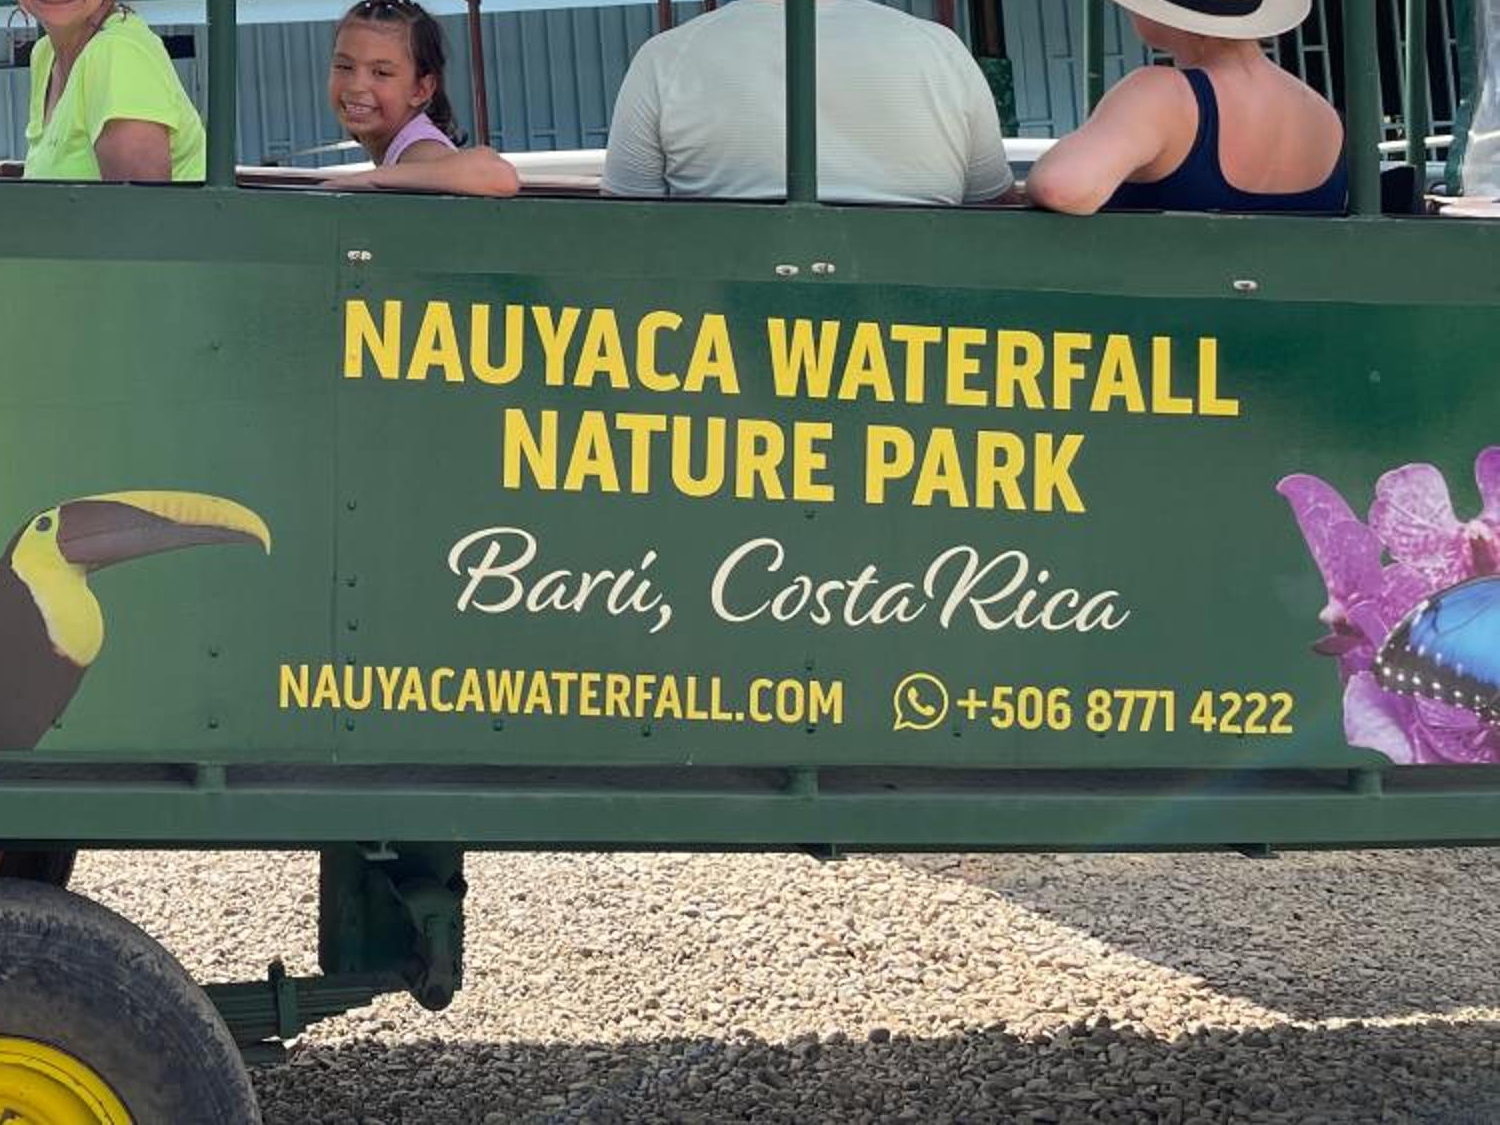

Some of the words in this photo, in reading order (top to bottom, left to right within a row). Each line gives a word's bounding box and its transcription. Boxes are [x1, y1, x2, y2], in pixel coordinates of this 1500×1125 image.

[344, 299, 739, 394] NAUYACA
[768, 318, 1239, 416] WATERFALL
[504, 408, 835, 502] NATURE
[866, 425, 1085, 513] PARK
[447, 527, 672, 634] Barú,
[711, 537, 926, 627] Costa
[924, 545, 1131, 632] Rica
[279, 664, 843, 724] NAUYACAWATERFALL.COM
[957, 686, 1072, 730] +506
[1086, 689, 1176, 732] 8771
[1190, 691, 1294, 733] 4222
